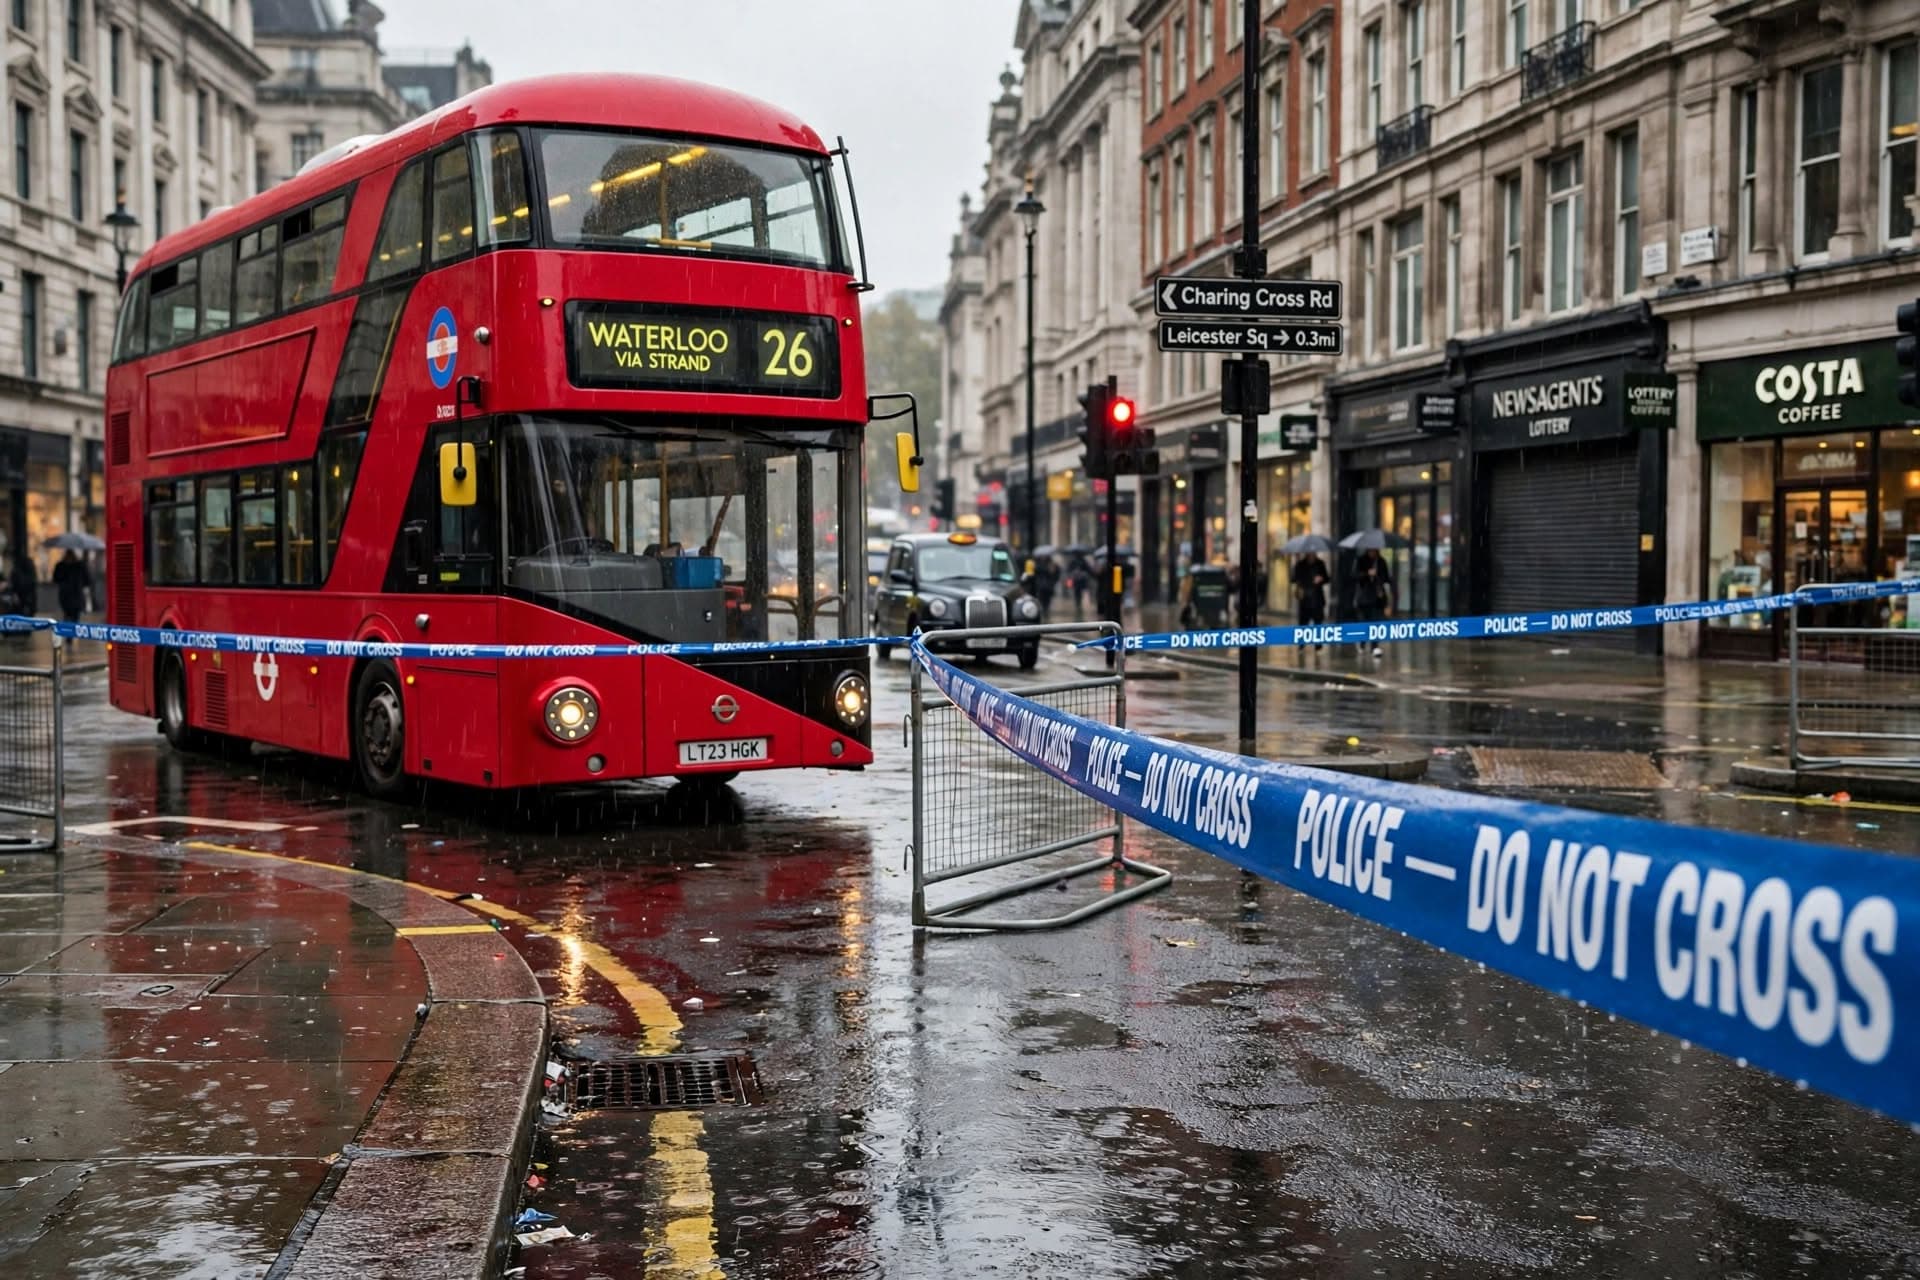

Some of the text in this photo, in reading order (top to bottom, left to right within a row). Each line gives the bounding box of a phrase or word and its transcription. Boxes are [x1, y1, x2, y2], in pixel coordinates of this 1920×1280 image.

[1181, 286, 1333, 310] Charing Cross Rd
[588, 321, 728, 353] WATERLOO
[1167, 326, 1335, 349] Leicester Sq 0.3mi
[615, 350, 711, 372] VIA STRAND
[763, 328, 813, 377] 26
[1755, 358, 1865, 403] COSTA
[1492, 375, 1603, 419] NEWSAGENTS
[1778, 404, 1842, 424] COFFEE
[1529, 416, 1571, 437] LOTTERY
[1294, 627, 1342, 643] POLICE
[1369, 624, 1386, 640] DO
[1390, 623, 1415, 639] NOT
[1418, 621, 1458, 637] CROSS
[1484, 617, 1528, 633] POLICE
[1551, 614, 1568, 630] DO
[1570, 612, 1593, 628] NOT
[1595, 610, 1632, 626] CROSS
[252, 638, 274, 651] NOT
[274, 640, 305, 653] CROSS
[627, 643, 681, 655] POLICE
[1171, 634, 1189, 647] DO
[1193, 633, 1219, 646] NOT
[1222, 631, 1265, 645] CROSS
[687, 741, 759, 761] LT23 HGK
[1085, 735, 1130, 796] POLICE
[1141, 751, 1168, 814] DO
[1162, 758, 1201, 825] NOT
[1195, 765, 1259, 849] CROSS
[1294, 789, 1405, 901] POLICE
[1467, 825, 1530, 945] DO
[1537, 839, 1652, 981] NOT
[1654, 862, 1898, 1065] CROSS
